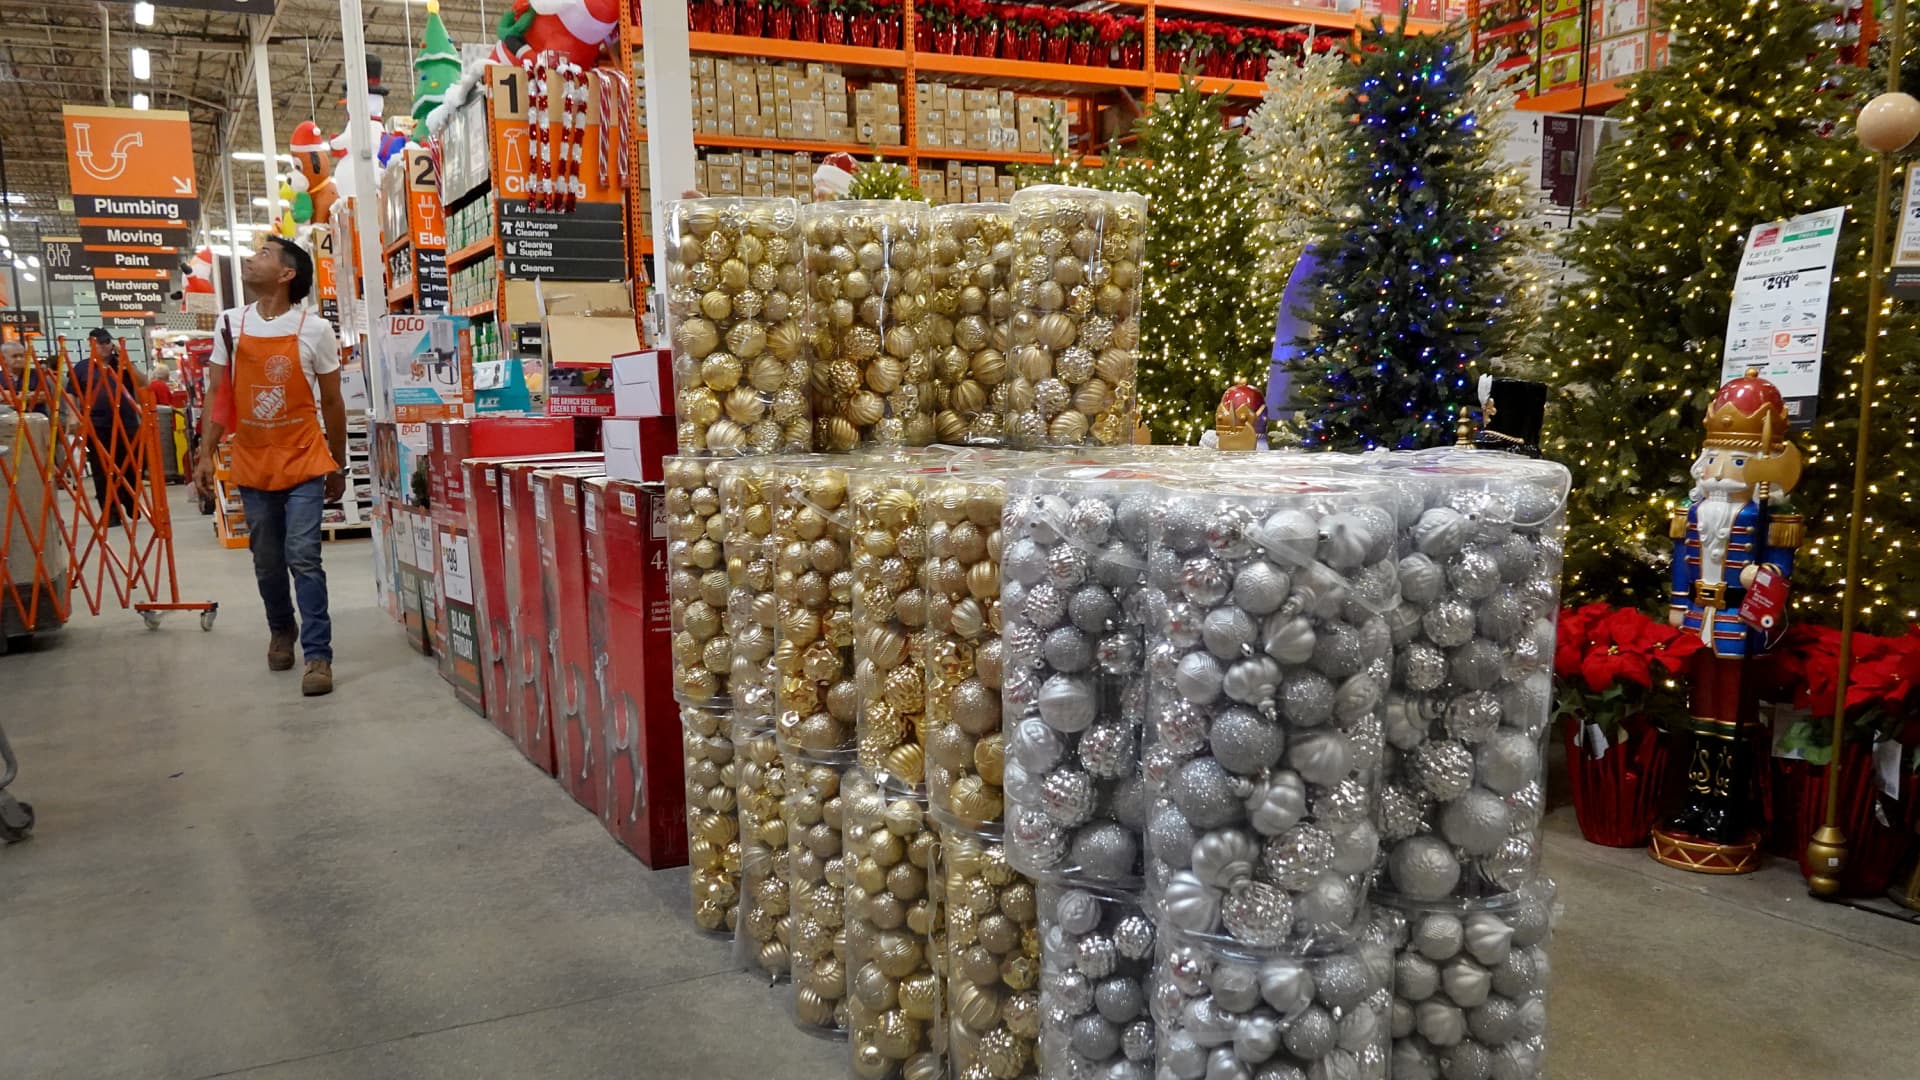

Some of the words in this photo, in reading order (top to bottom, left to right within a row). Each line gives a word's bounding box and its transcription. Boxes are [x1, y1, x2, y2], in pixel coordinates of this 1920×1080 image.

[499, 73, 519, 114] 1
[414, 155, 436, 186] 2
[94, 198, 179, 219] Plumbing
[514, 220, 525, 229] All
[527, 220, 559, 231] Purpose
[106, 228, 163, 246] Moving
[515, 228, 550, 238] Cleaners
[320, 233, 333, 255] 4
[519, 240, 553, 252] Cleaning
[519, 248, 553, 258] Supplies
[115, 254, 150, 267] Paint
[520, 263, 555, 274] Cleaners
[54, 273, 94, 281] Restrooms
[106, 280, 160, 291] Hardware
[101, 292, 132, 302] Power
[134, 292, 162, 302] Tools
[113, 317, 145, 327] Roofing
[550, 397, 560, 405] THE
[561, 397, 580, 405] GRINCH
[451, 609, 472, 637] BLACK
[452, 632, 473, 661] FRIDAY
